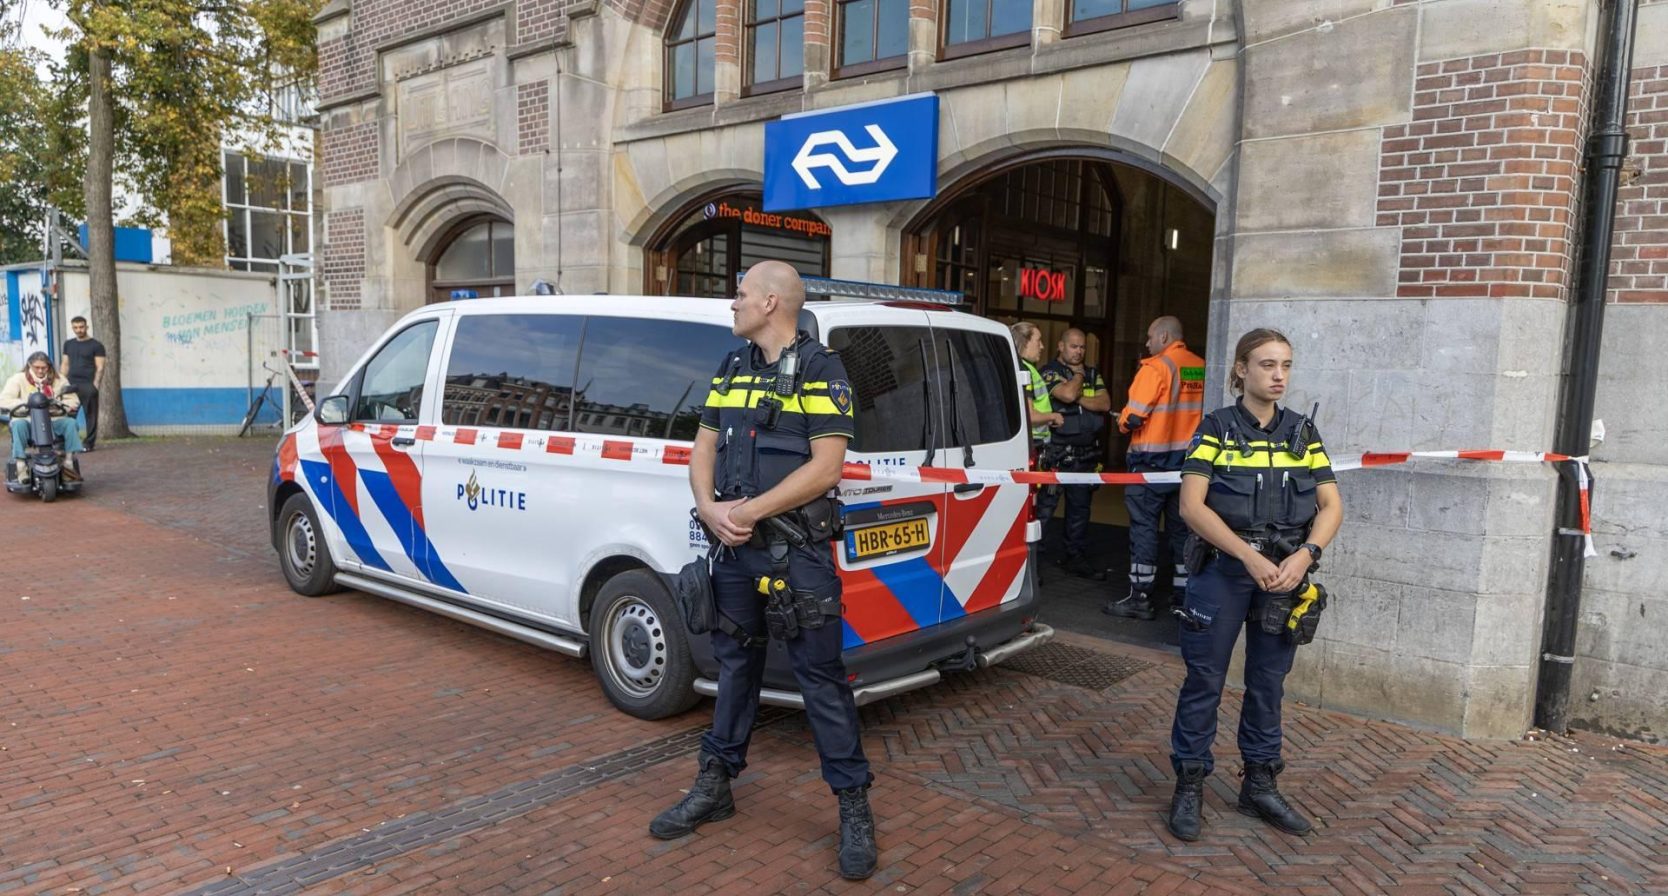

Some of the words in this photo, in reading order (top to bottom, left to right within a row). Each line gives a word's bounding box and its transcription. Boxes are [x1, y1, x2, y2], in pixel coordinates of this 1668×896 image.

[719, 202, 740, 217] the
[743, 207, 782, 227] doner
[1020, 268, 1066, 301] KIOSK
[162, 310, 217, 328] BLOEMEN
[223, 303, 268, 318] HOUDEN
[457, 483, 526, 511] POLITIE
[859, 523, 925, 552] HBR-65-H
